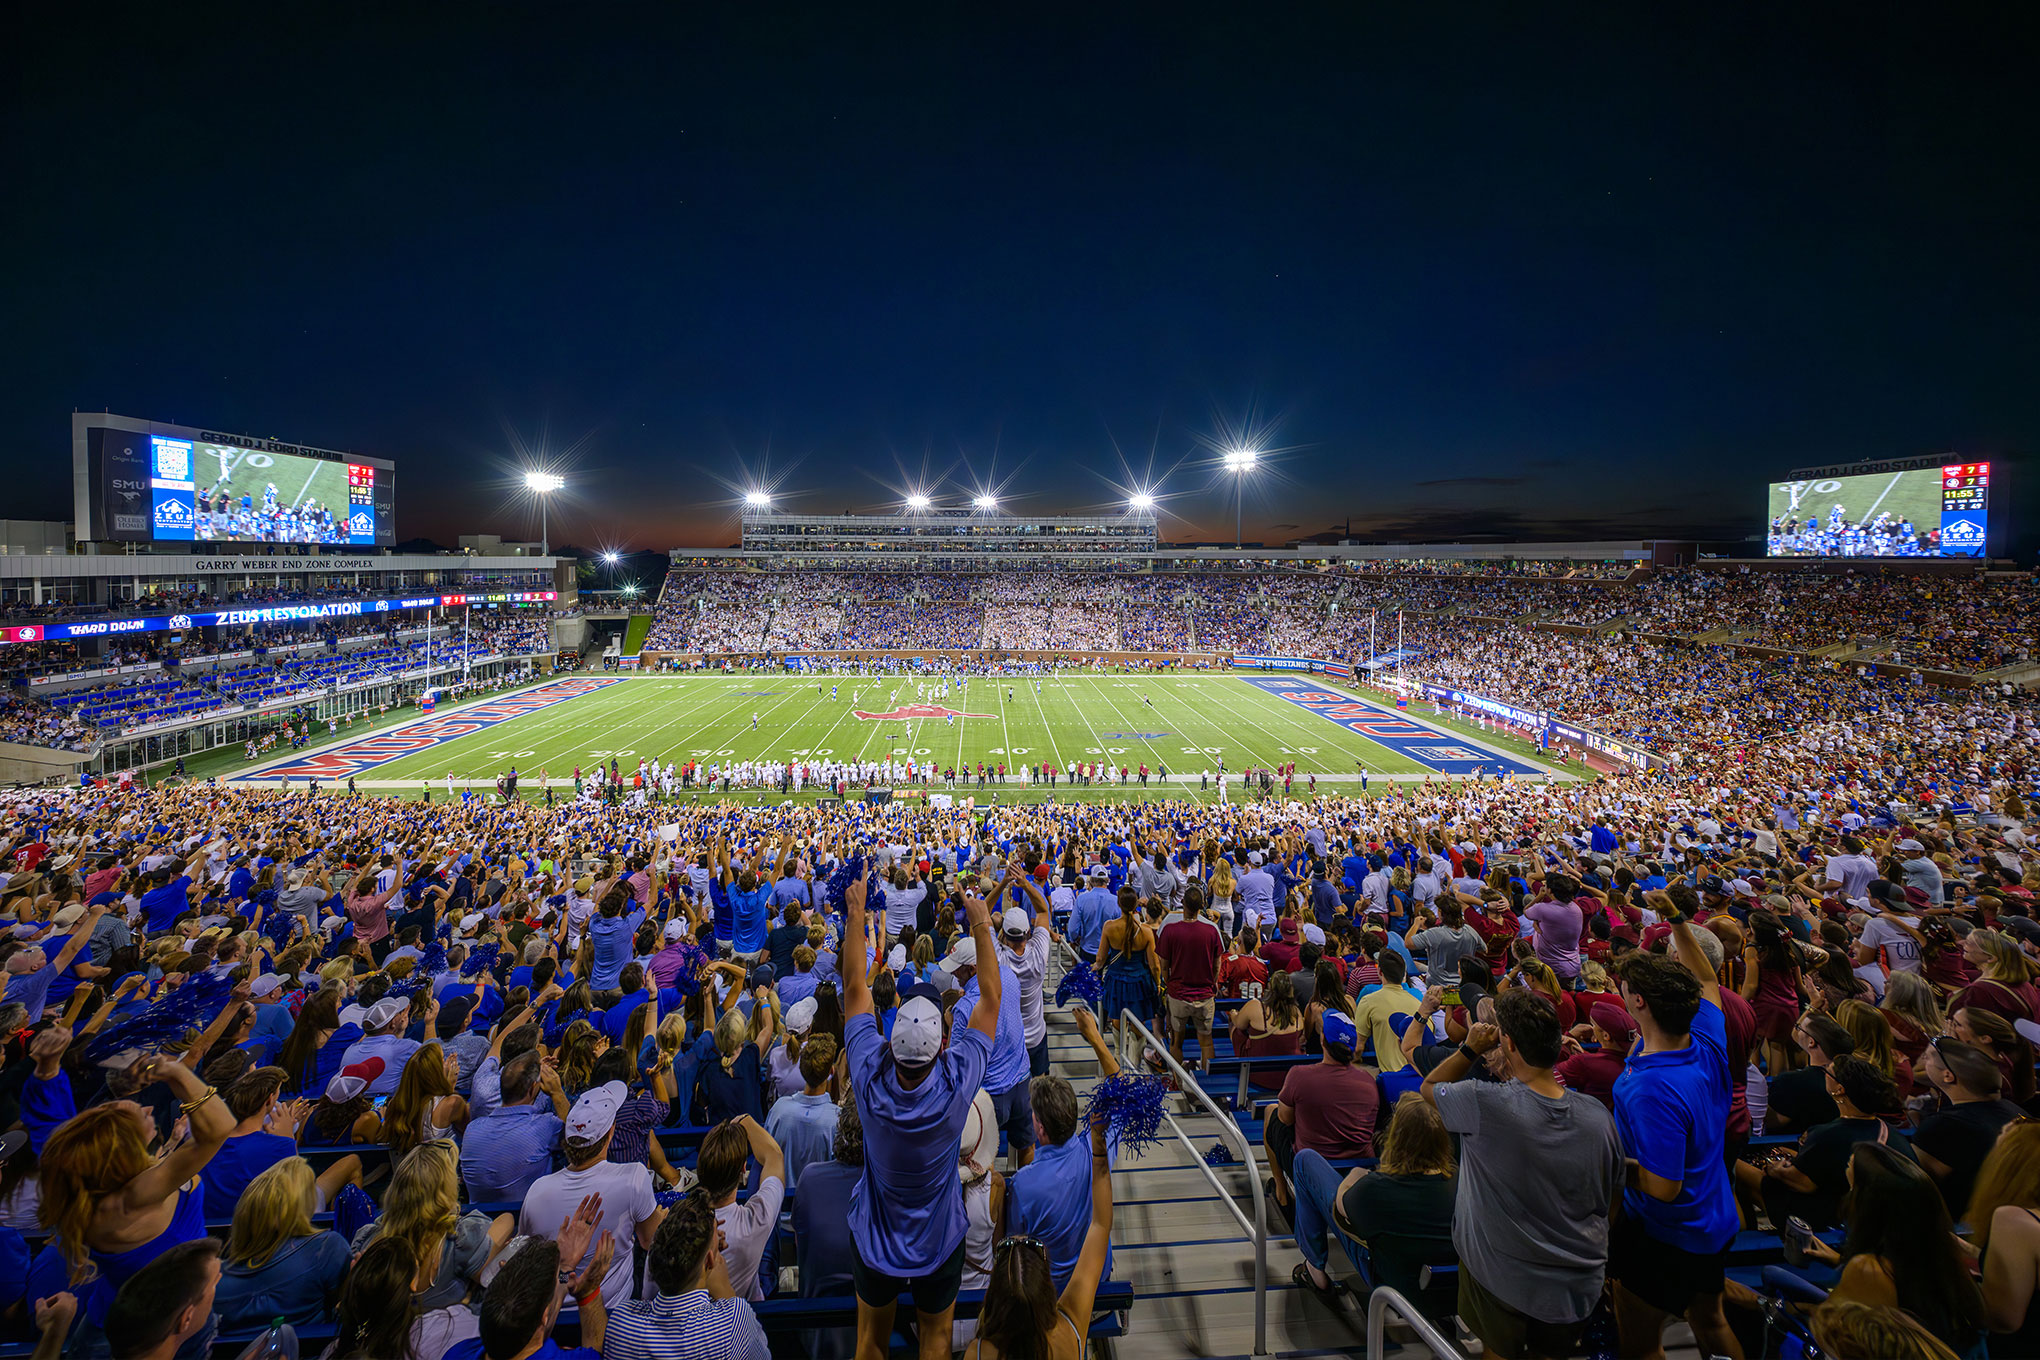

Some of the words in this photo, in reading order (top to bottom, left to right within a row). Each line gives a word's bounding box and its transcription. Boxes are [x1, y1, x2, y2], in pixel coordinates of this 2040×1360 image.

[200, 431, 253, 448] GERALD
[267, 442, 298, 456] FORD
[299, 447, 343, 461] STADIUM
[1789, 469, 1838, 481] GERALD
[1852, 462, 1893, 474] FORD
[1967, 466, 1975, 474] 7
[112, 480, 145, 490] SMU
[1944, 489, 1974, 498] 11:55
[154, 512, 193, 520] ZEUS
[196, 561, 237, 570] GARRY
[242, 561, 278, 569] WEBER
[282, 560, 302, 569] END
[305, 560, 331, 568] ZONE
[334, 560, 373, 568] COMPLEX
[216, 610, 260, 626] ZEUS
[262, 602, 362, 622] RESTORATION
[1279, 691, 1448, 740] SMU
[246, 678, 620, 778] MUSTANGS
[690, 749, 736, 757] 30
[141, 861, 148, 871] 11
[378, 875, 387, 893] 11
[1239, 981, 1263, 999] 10
